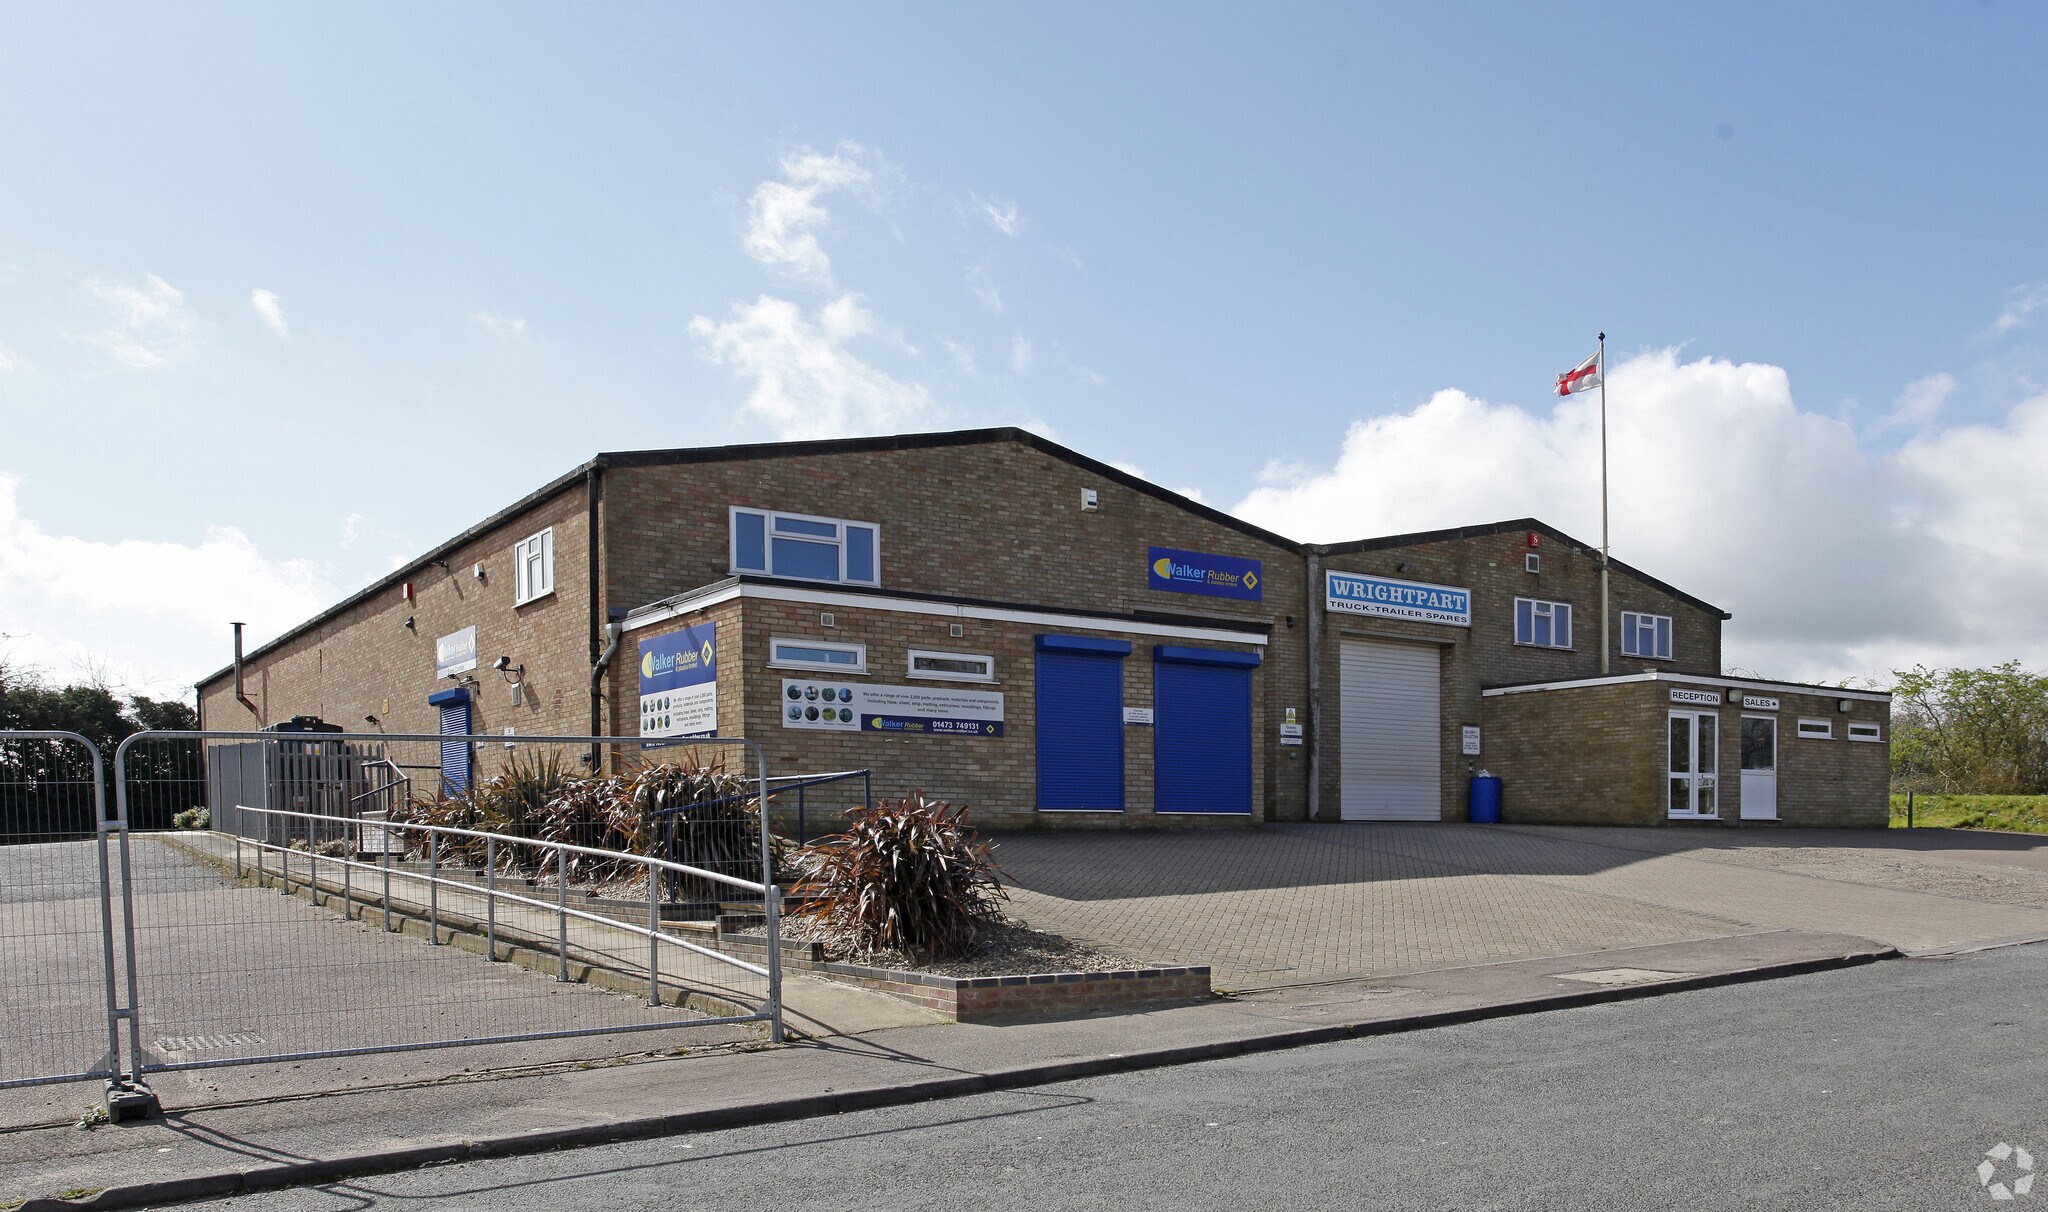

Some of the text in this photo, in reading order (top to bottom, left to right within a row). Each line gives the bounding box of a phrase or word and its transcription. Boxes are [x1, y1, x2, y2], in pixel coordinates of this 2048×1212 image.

[1164, 562, 1239, 582] Walker Rubber
[1332, 580, 1464, 610] WRIGHTPART
[1330, 601, 1467, 623] TRUCK-TRAILER SPARES
[649, 650, 698, 671] Walker Rubber
[1672, 692, 1718, 702] RECEPTION
[1745, 698, 1770, 706] SALES
[878, 720, 903, 728] Walker
[956, 722, 979, 730] 749131
